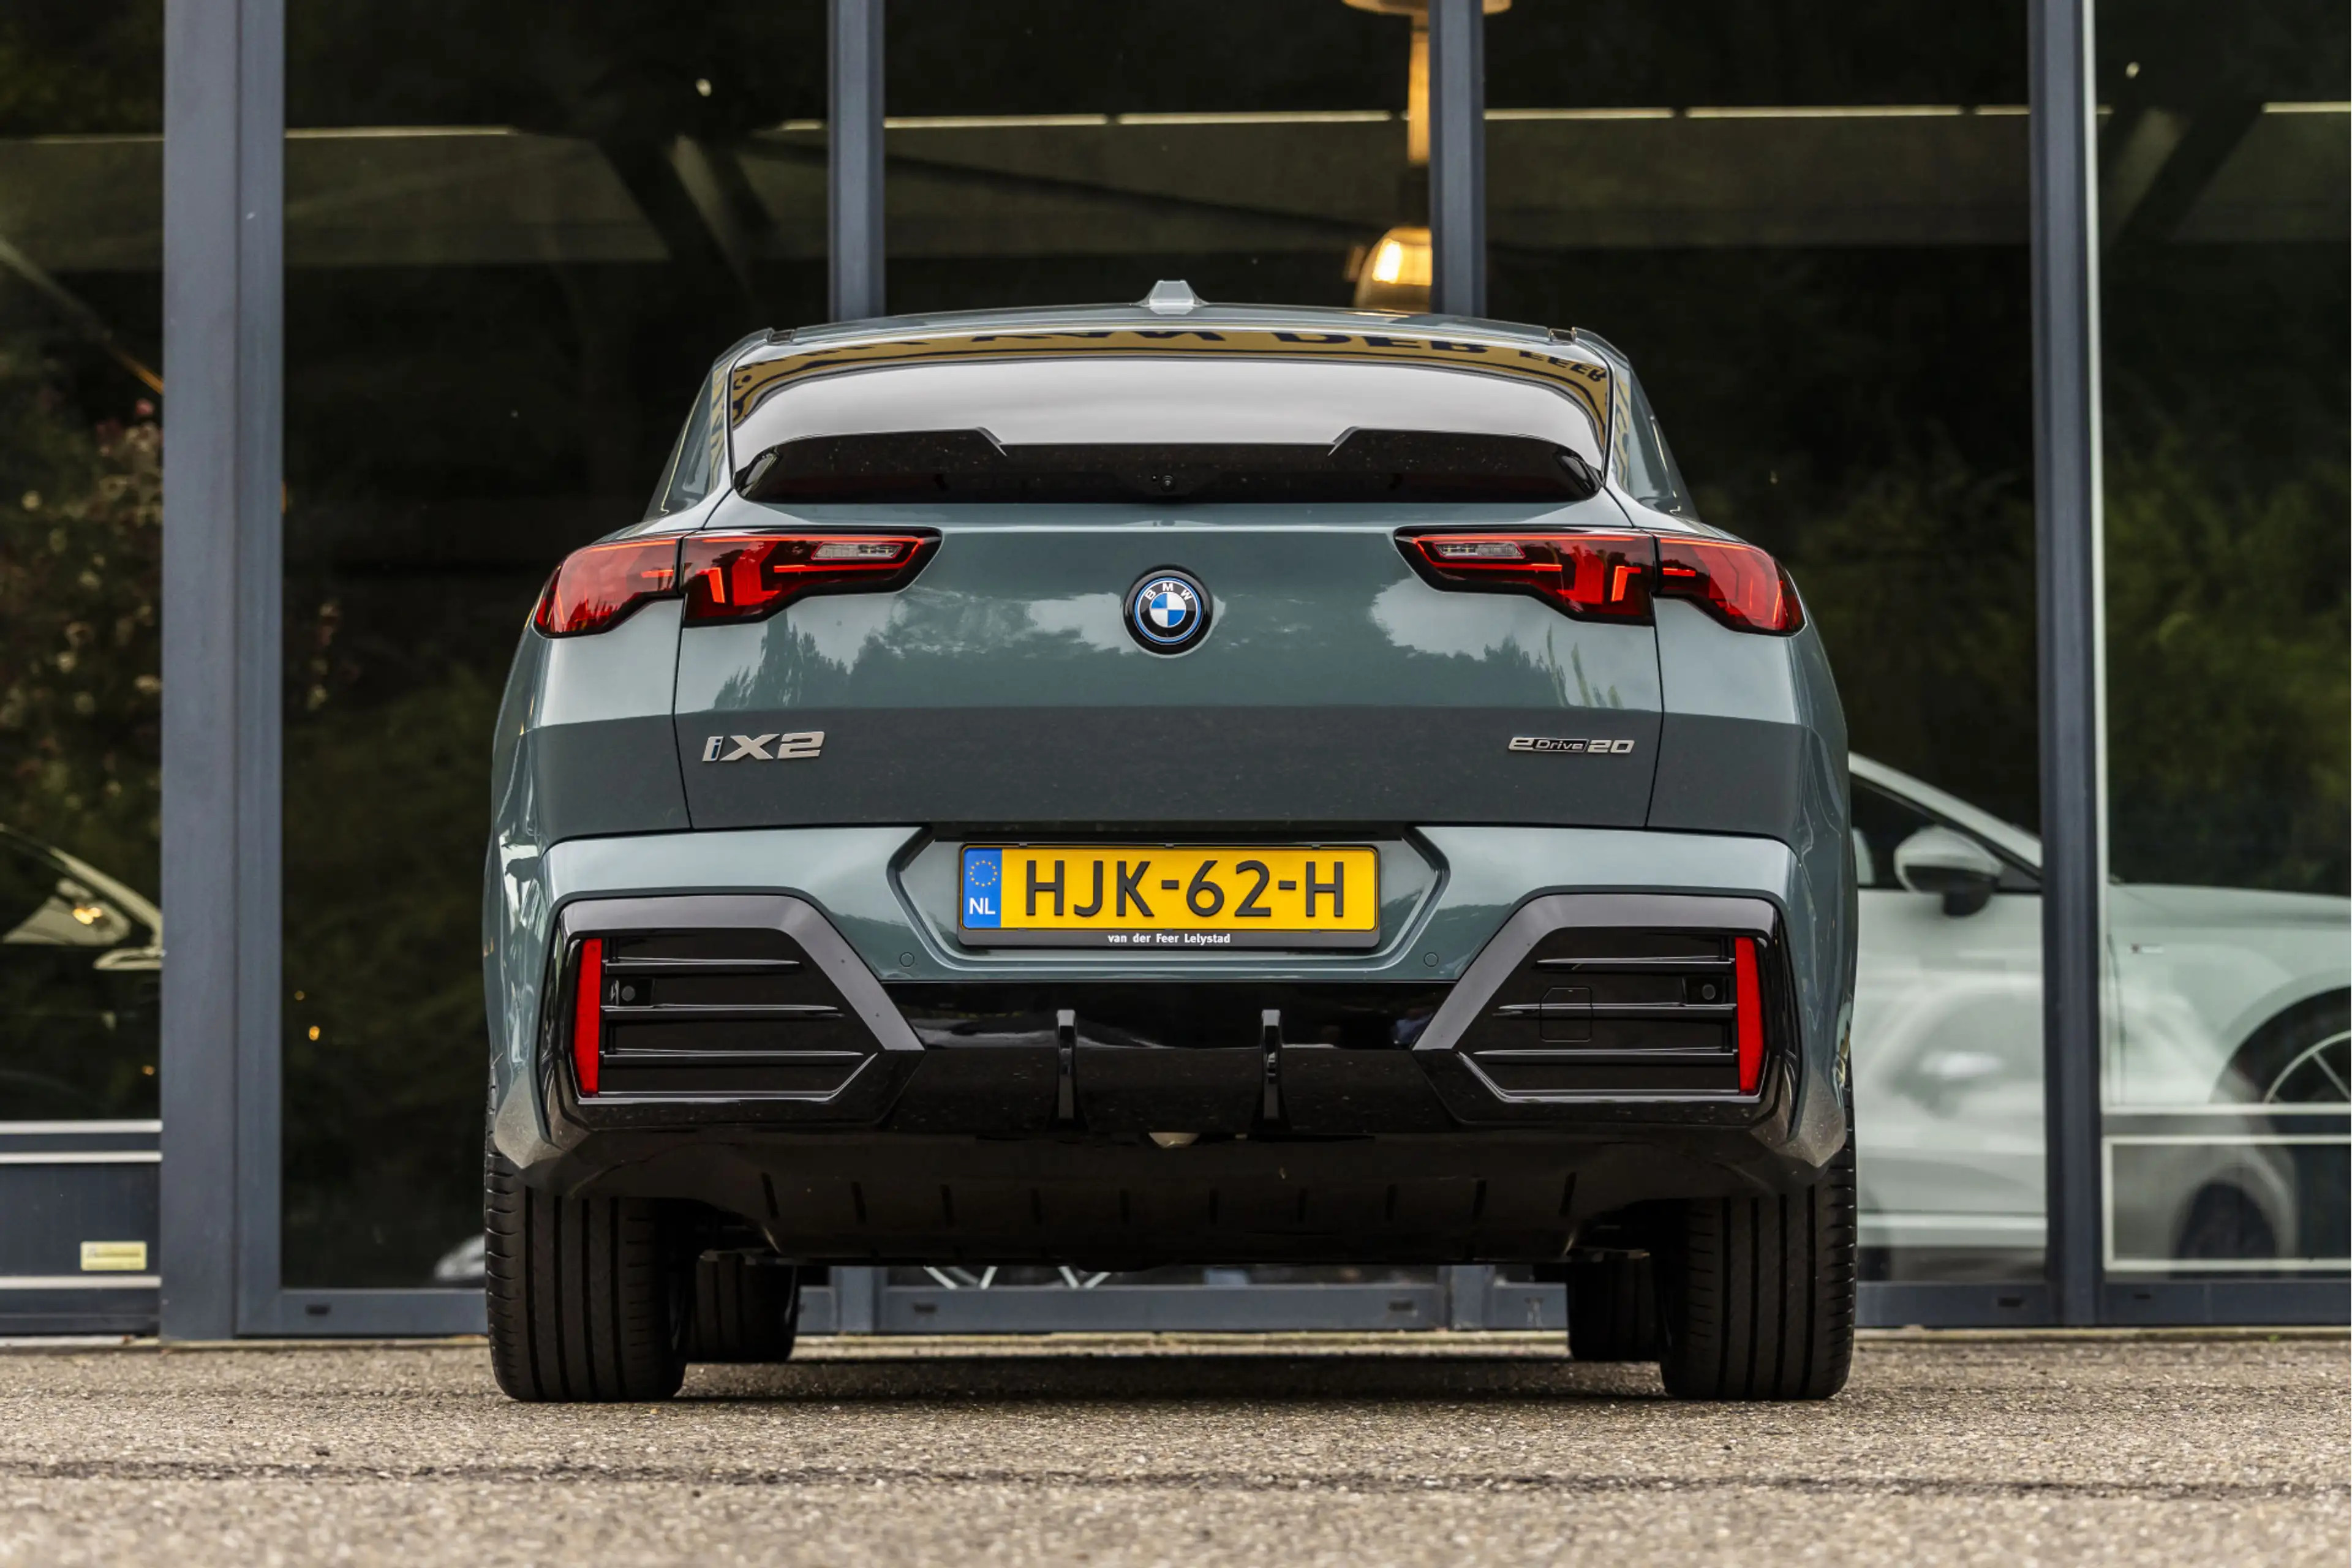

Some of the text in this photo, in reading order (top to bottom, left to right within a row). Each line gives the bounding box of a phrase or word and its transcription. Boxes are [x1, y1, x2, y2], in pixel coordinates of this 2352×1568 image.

[1144, 582, 1193, 601] BMW
[702, 731, 825, 761] iX2
[1025, 859, 1344, 918] HJK-62-H
[969, 897, 996, 915] NL
[1107, 933, 1231, 946] van der Feer Lelystad
